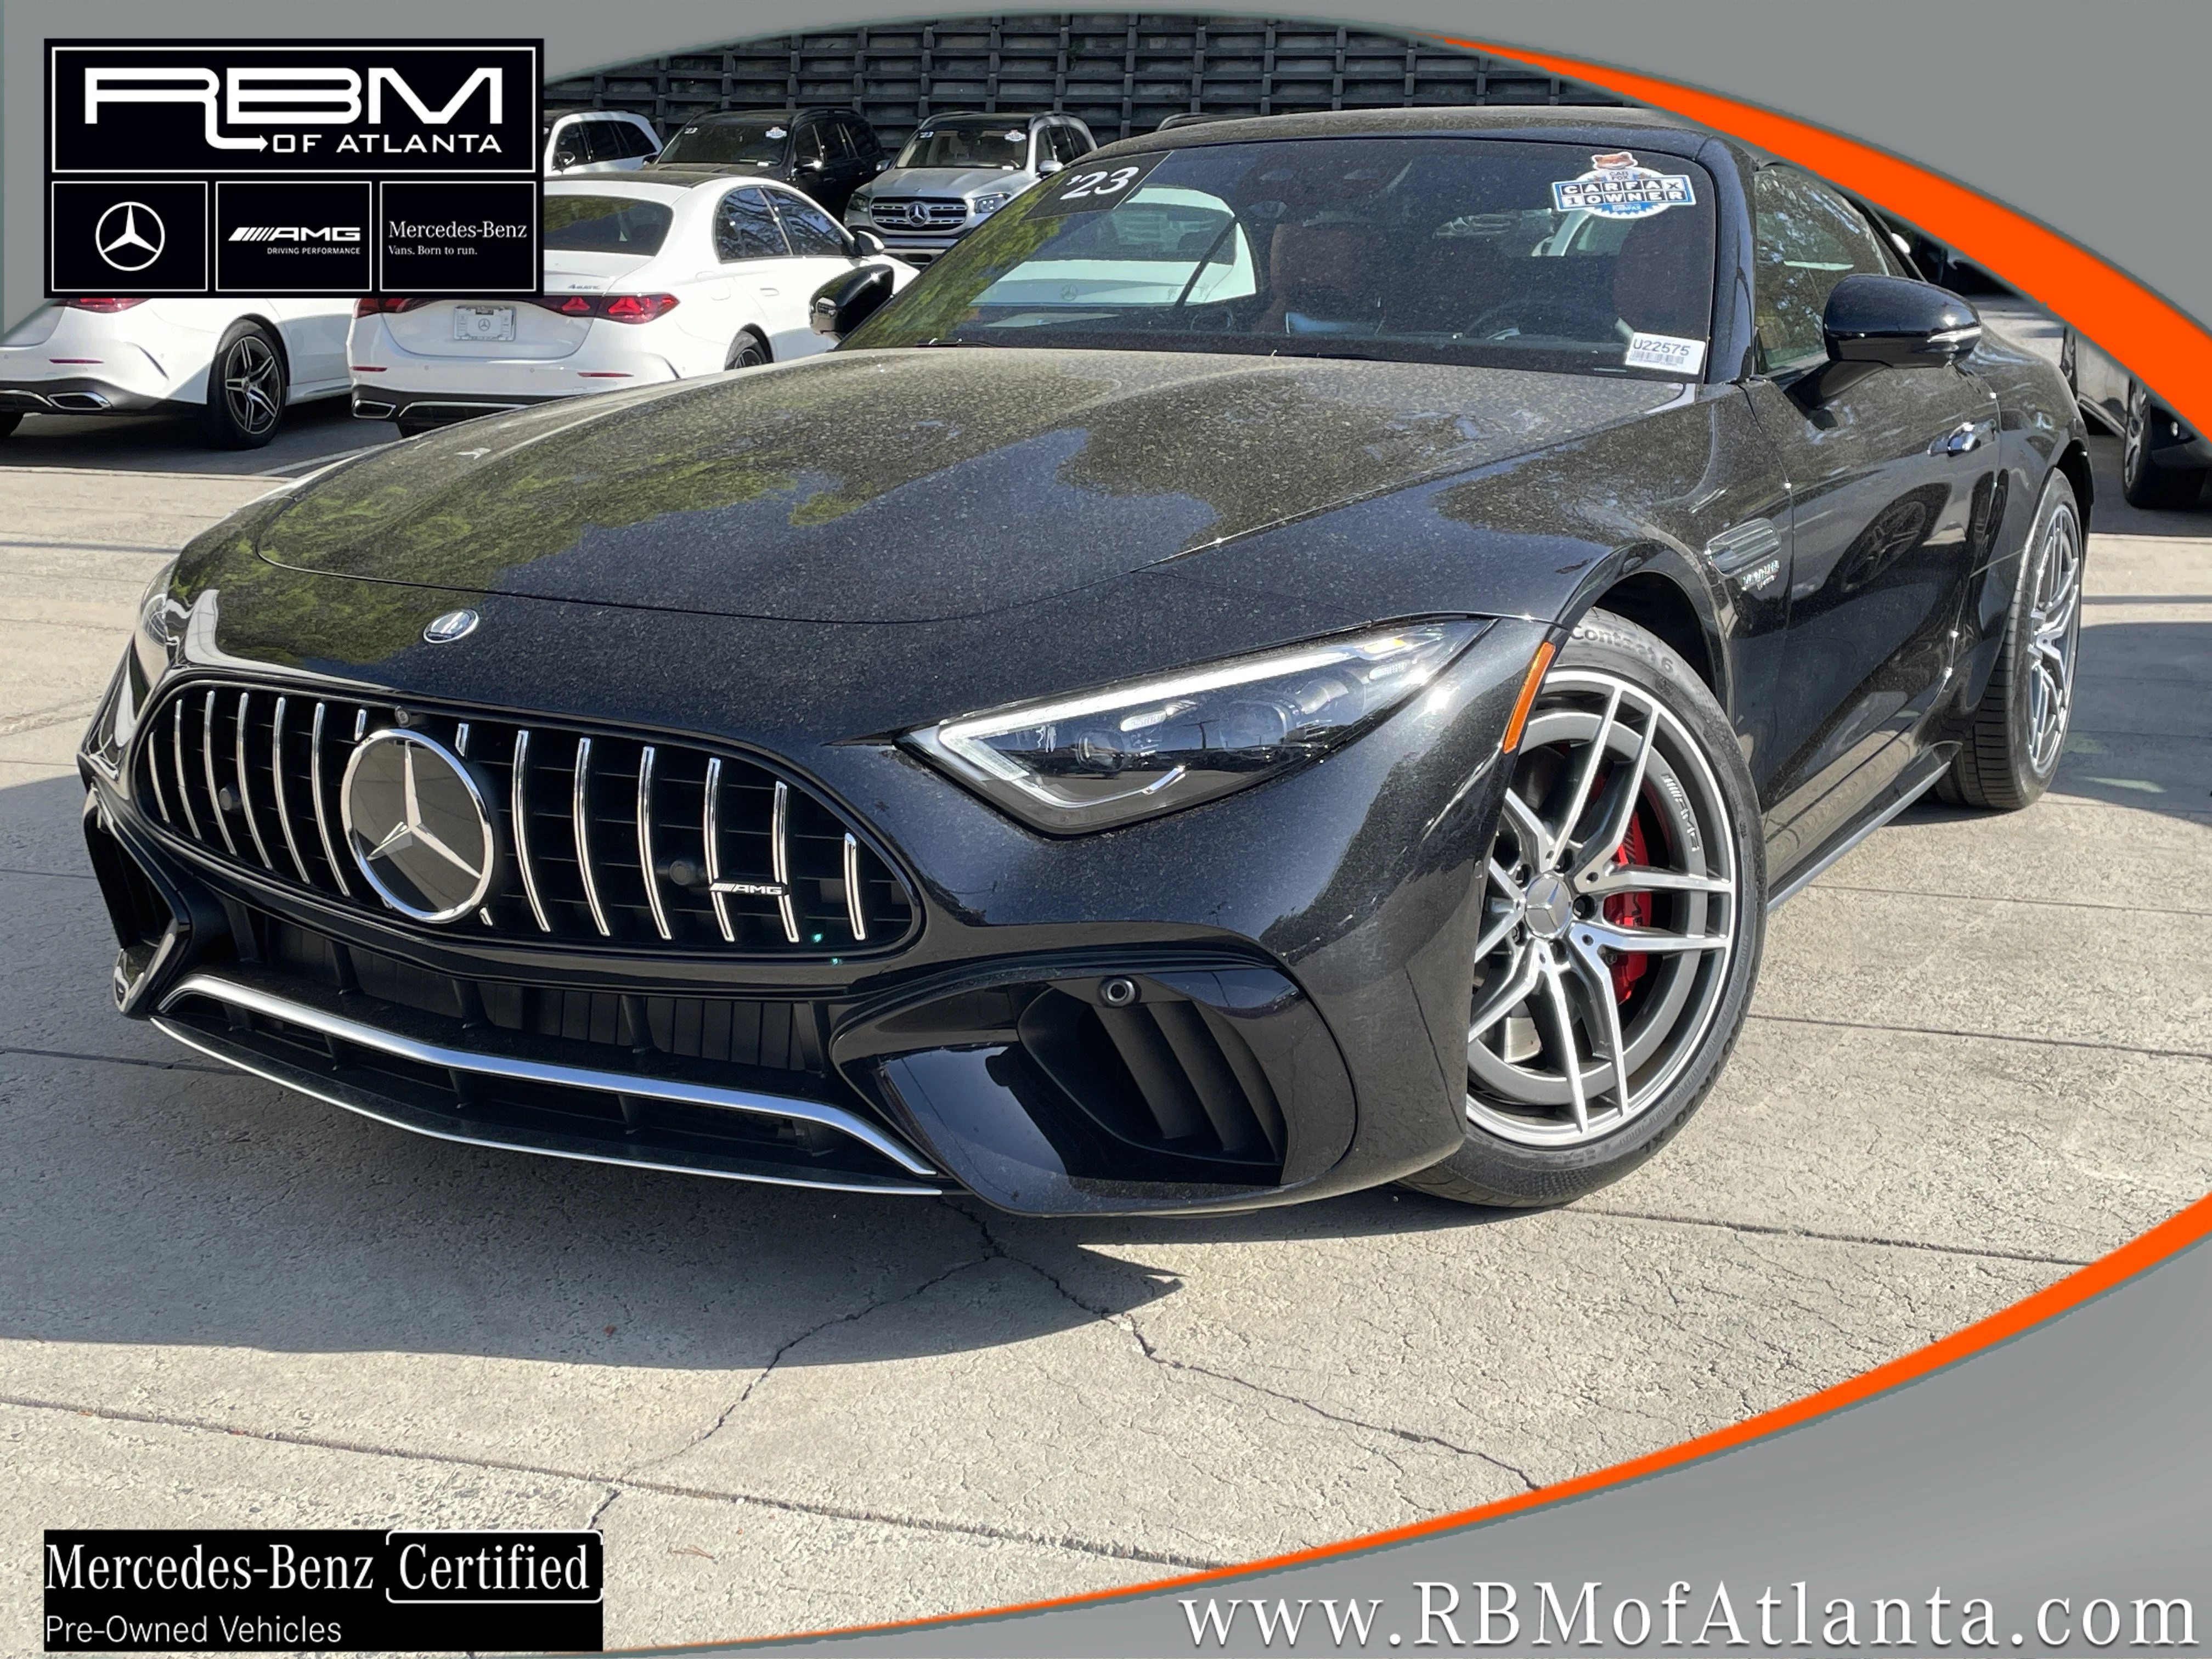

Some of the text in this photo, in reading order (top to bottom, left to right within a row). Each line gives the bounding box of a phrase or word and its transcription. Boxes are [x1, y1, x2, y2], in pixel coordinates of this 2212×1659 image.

[1564, 180, 1679, 194] CARFAX
[1587, 190, 1686, 204] OWNER
[1633, 338, 1691, 356] U22575
[1661, 657, 1674, 675] 6
[732, 884, 782, 895] AMG
